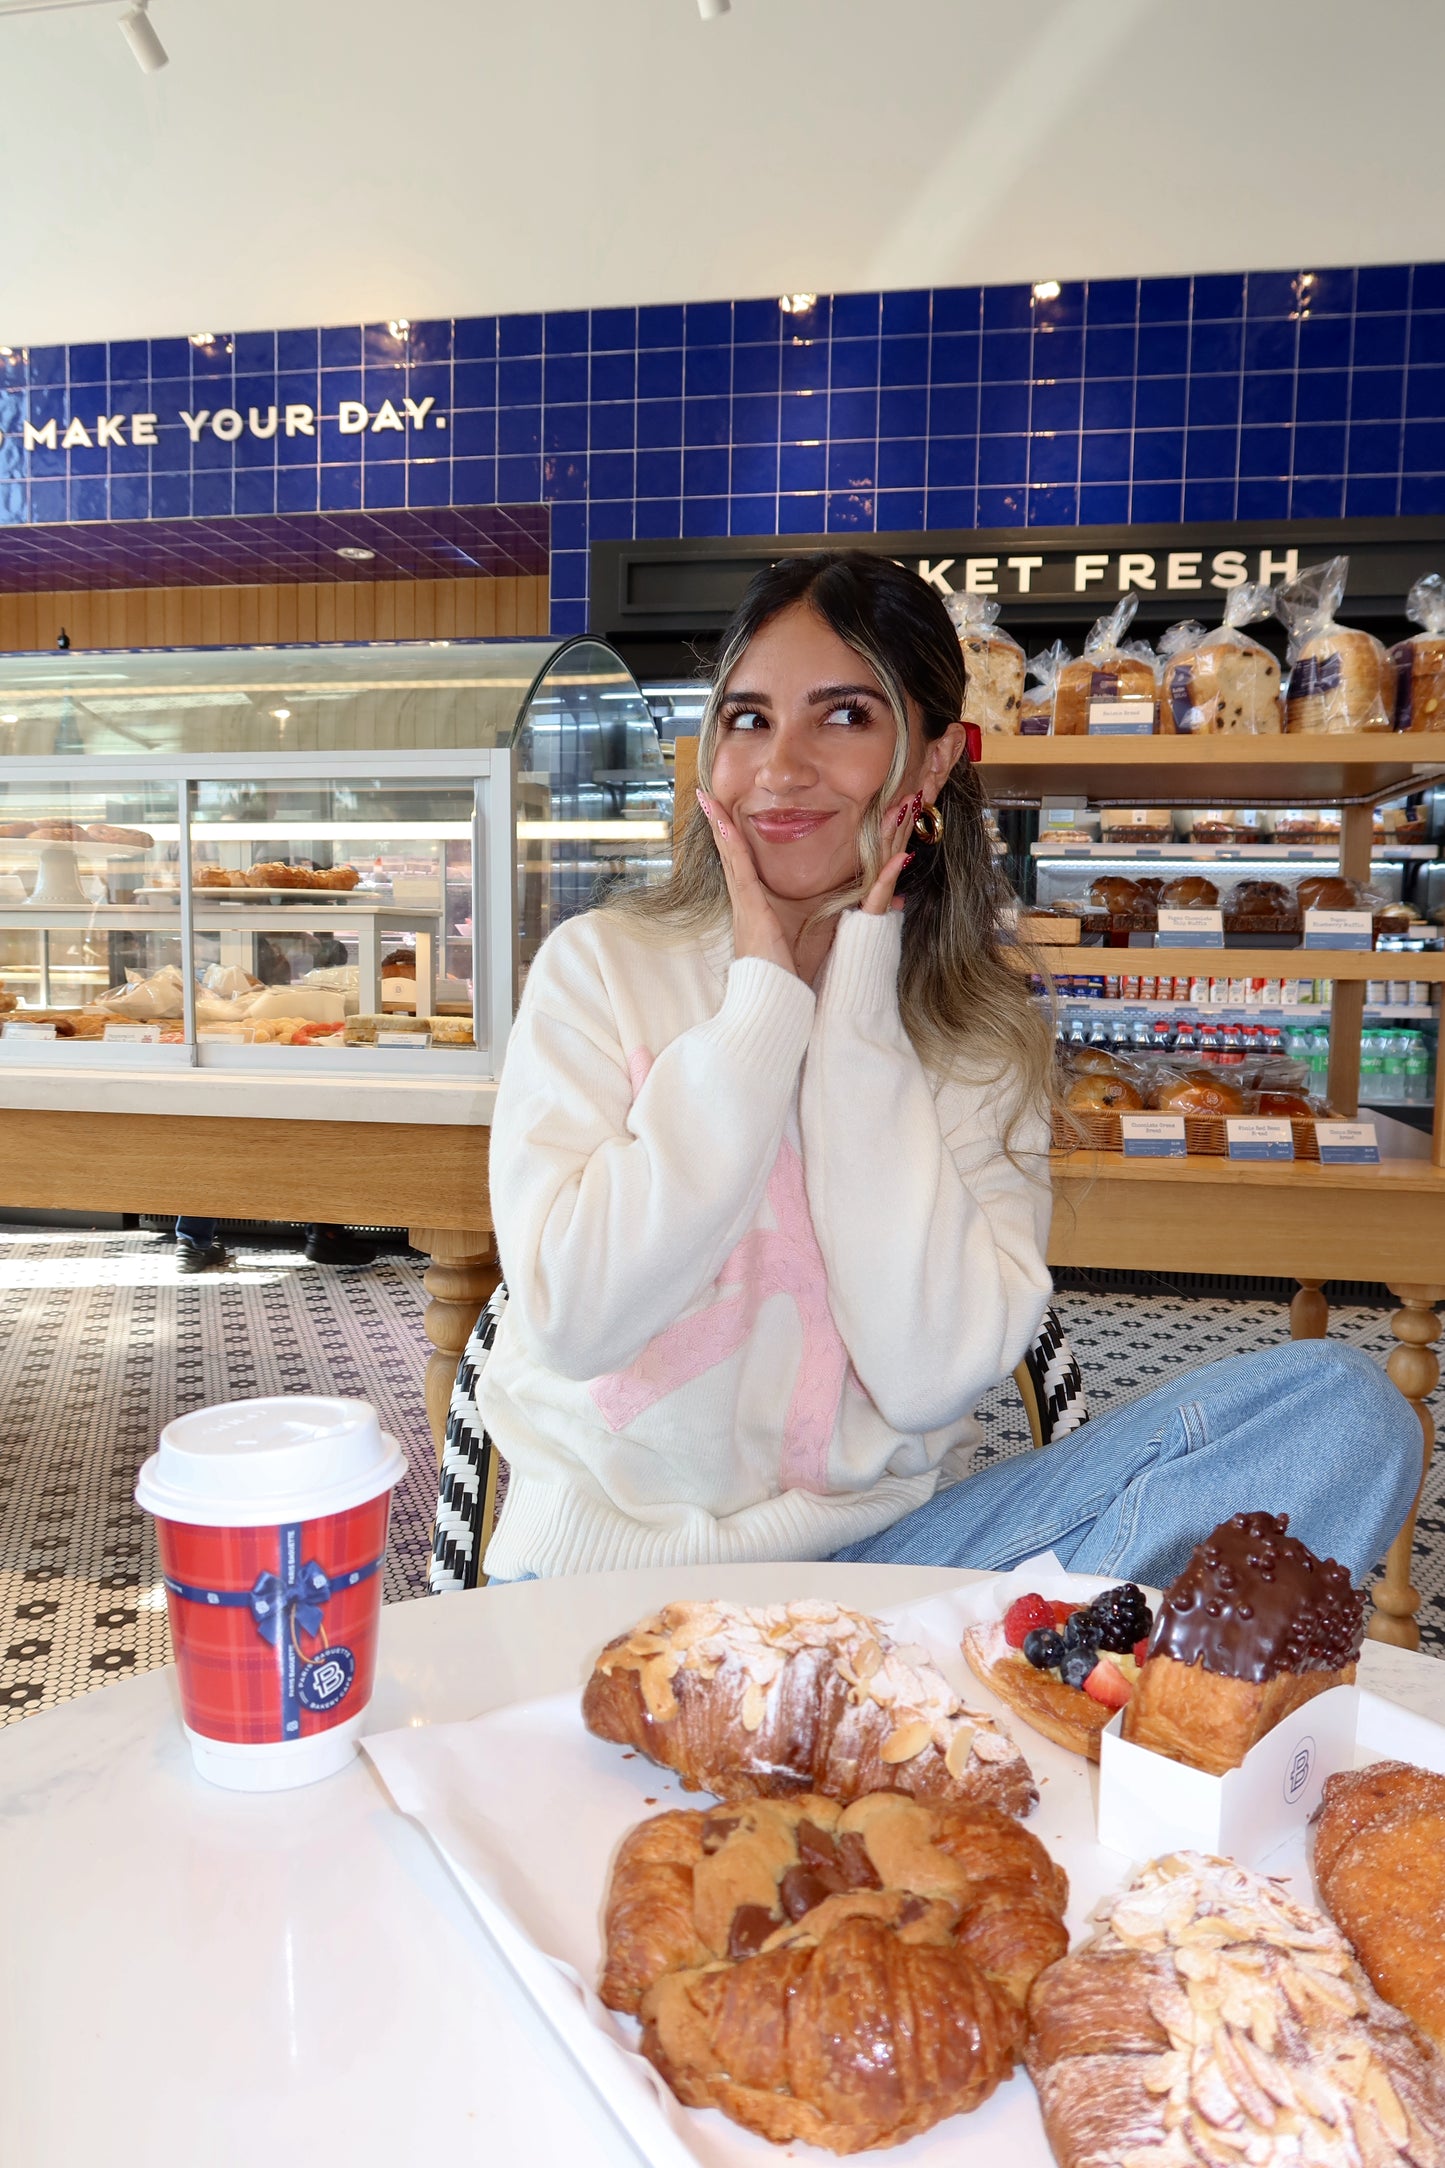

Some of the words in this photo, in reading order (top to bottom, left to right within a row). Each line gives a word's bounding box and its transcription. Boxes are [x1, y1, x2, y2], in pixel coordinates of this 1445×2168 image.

[23, 413, 158, 451] MAKE
[179, 404, 316, 442] YOUR
[338, 396, 447, 434] DAY.
[892, 556, 1043, 594] KET
[1074, 548, 1300, 592] FRESH
[287, 1530, 295, 1565] BAGUETTE
[298, 1663, 313, 1689] PARIS
[313, 1647, 352, 1663] BAGUETTE
[309, 1697, 340, 1710] BAKERY
